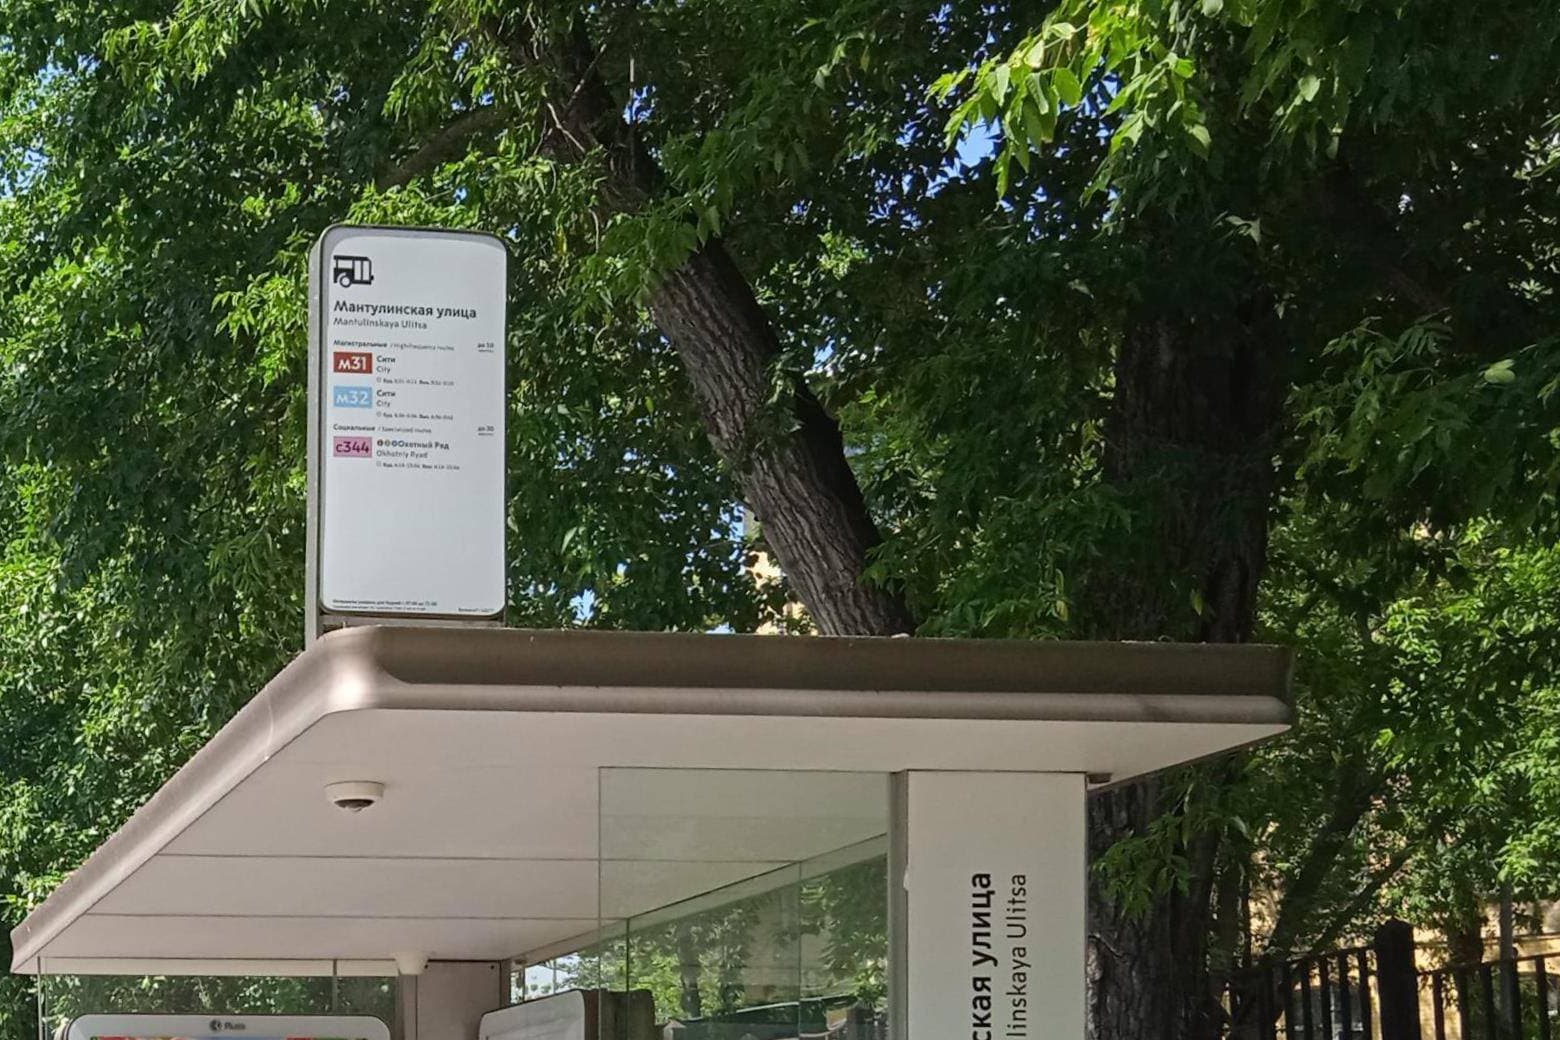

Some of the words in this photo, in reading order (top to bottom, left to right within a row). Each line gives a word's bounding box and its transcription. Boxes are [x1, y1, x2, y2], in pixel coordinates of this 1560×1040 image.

[333, 300, 433, 316] Мантулинская
[436, 306, 477, 319] улица
[333, 317, 400, 329] Mantulinskaya
[401, 320, 427, 330] Ulitsa
[376, 355, 396, 363] Сити
[376, 366, 391, 374] City
[376, 389, 396, 398] Сити
[376, 400, 391, 408] City
[1006, 874, 1027, 939] Ulitsa
[971, 872, 998, 967] улица
